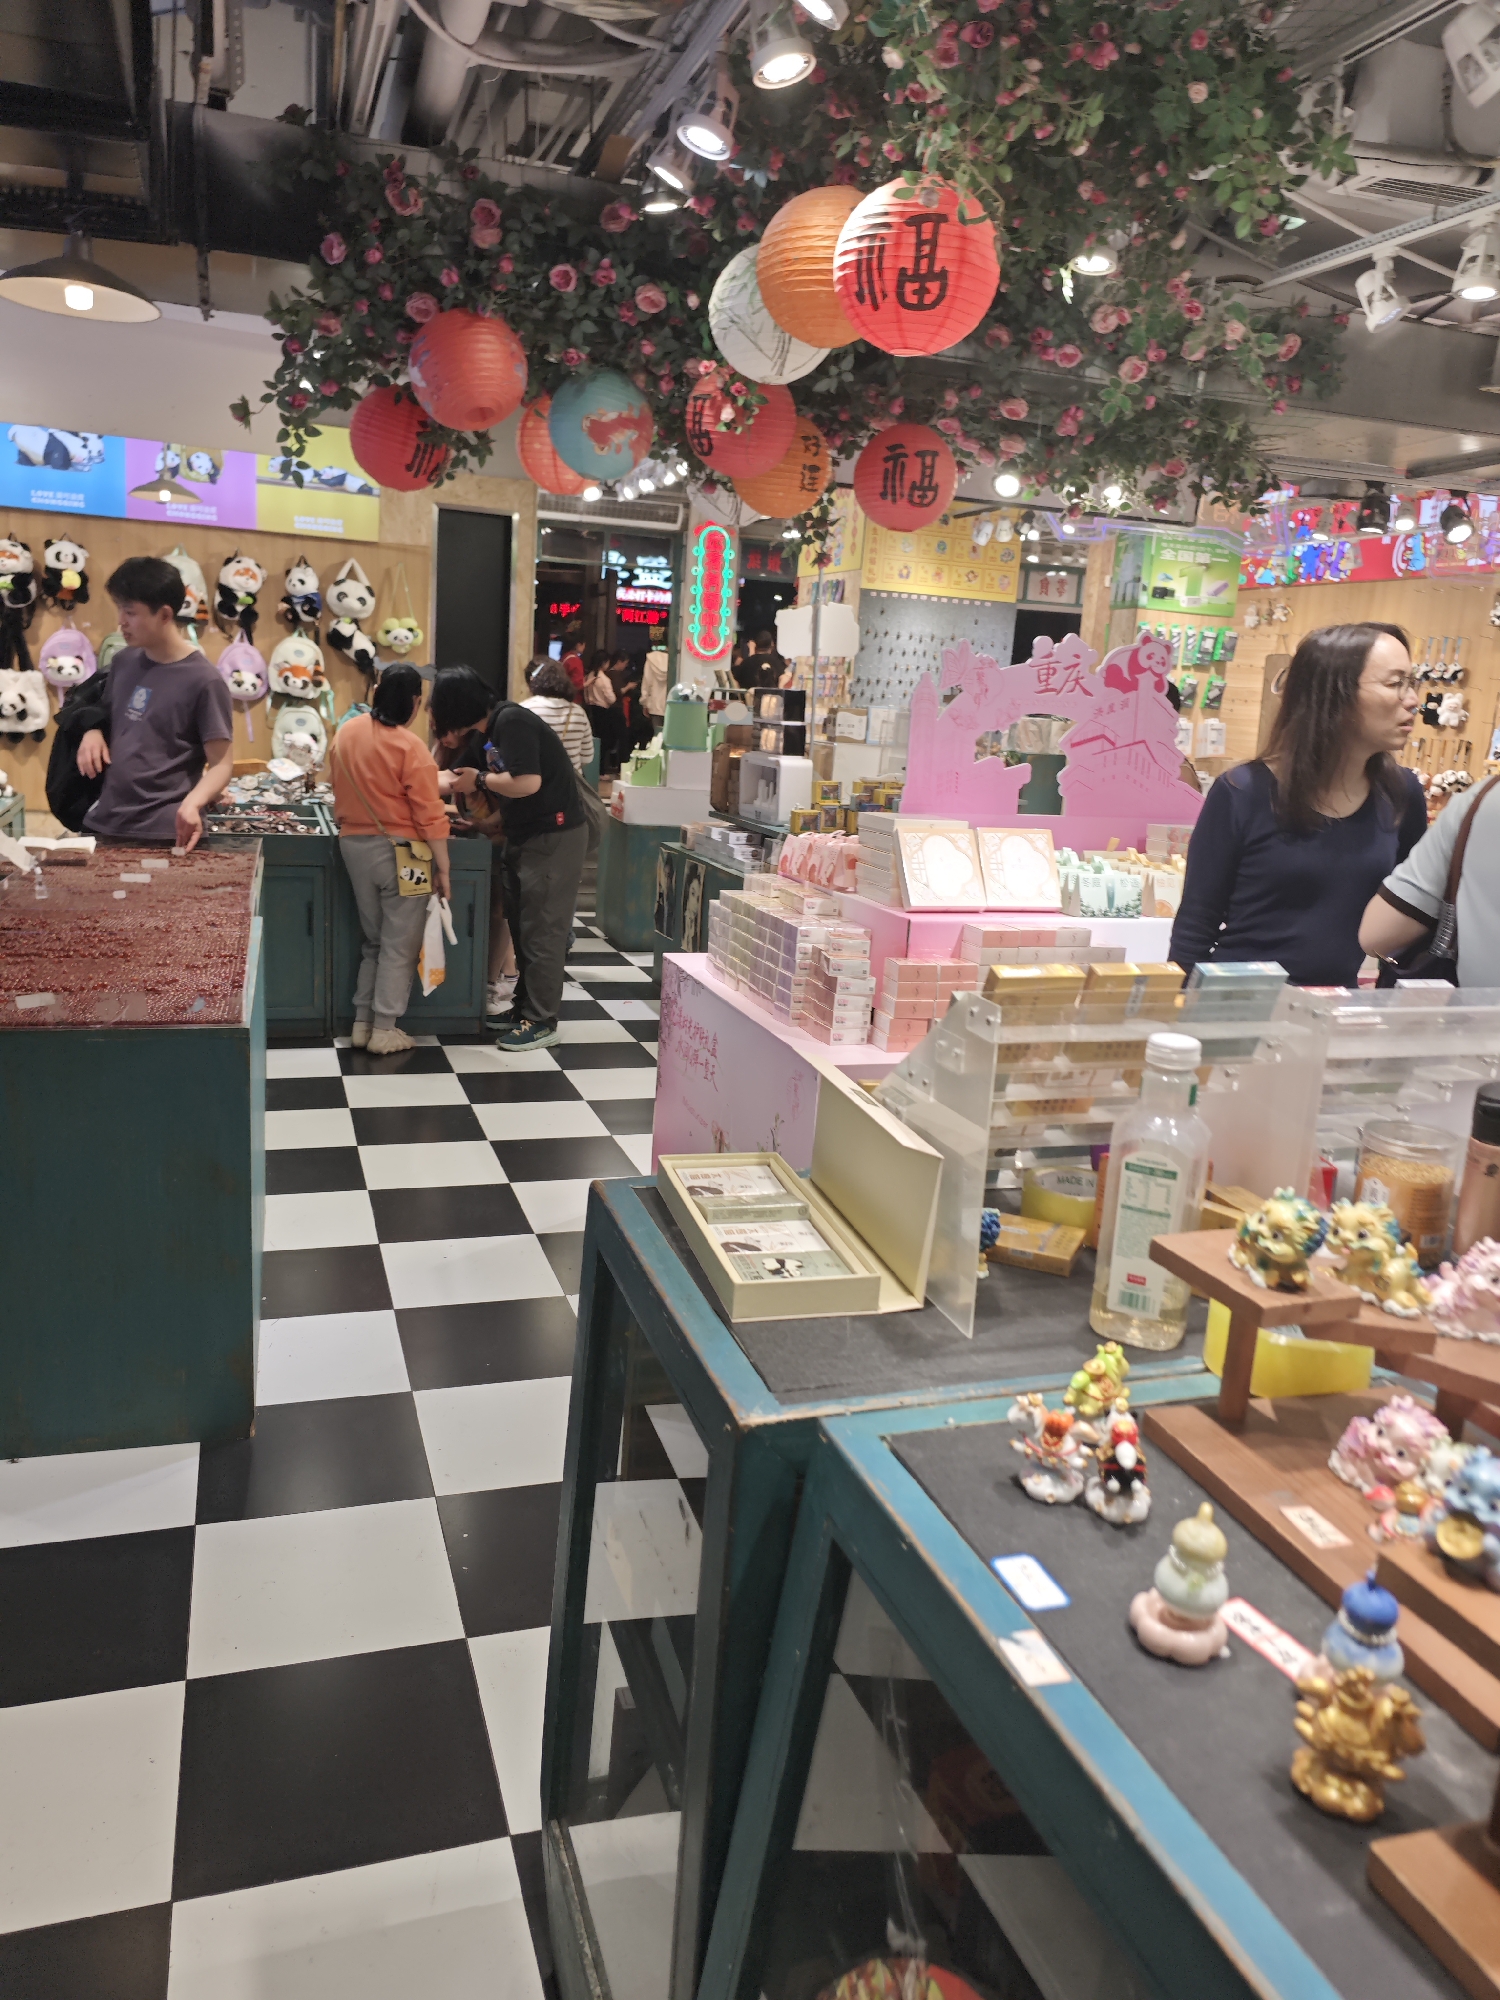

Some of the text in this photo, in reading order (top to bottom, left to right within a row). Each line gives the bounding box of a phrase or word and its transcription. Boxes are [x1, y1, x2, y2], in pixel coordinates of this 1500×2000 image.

[879, 443, 941, 508] 福
[1159, 548, 1230, 564] 全国第一
[1029, 652, 1094, 698] 重庆
[1056, 1174, 1083, 1187] MADE
